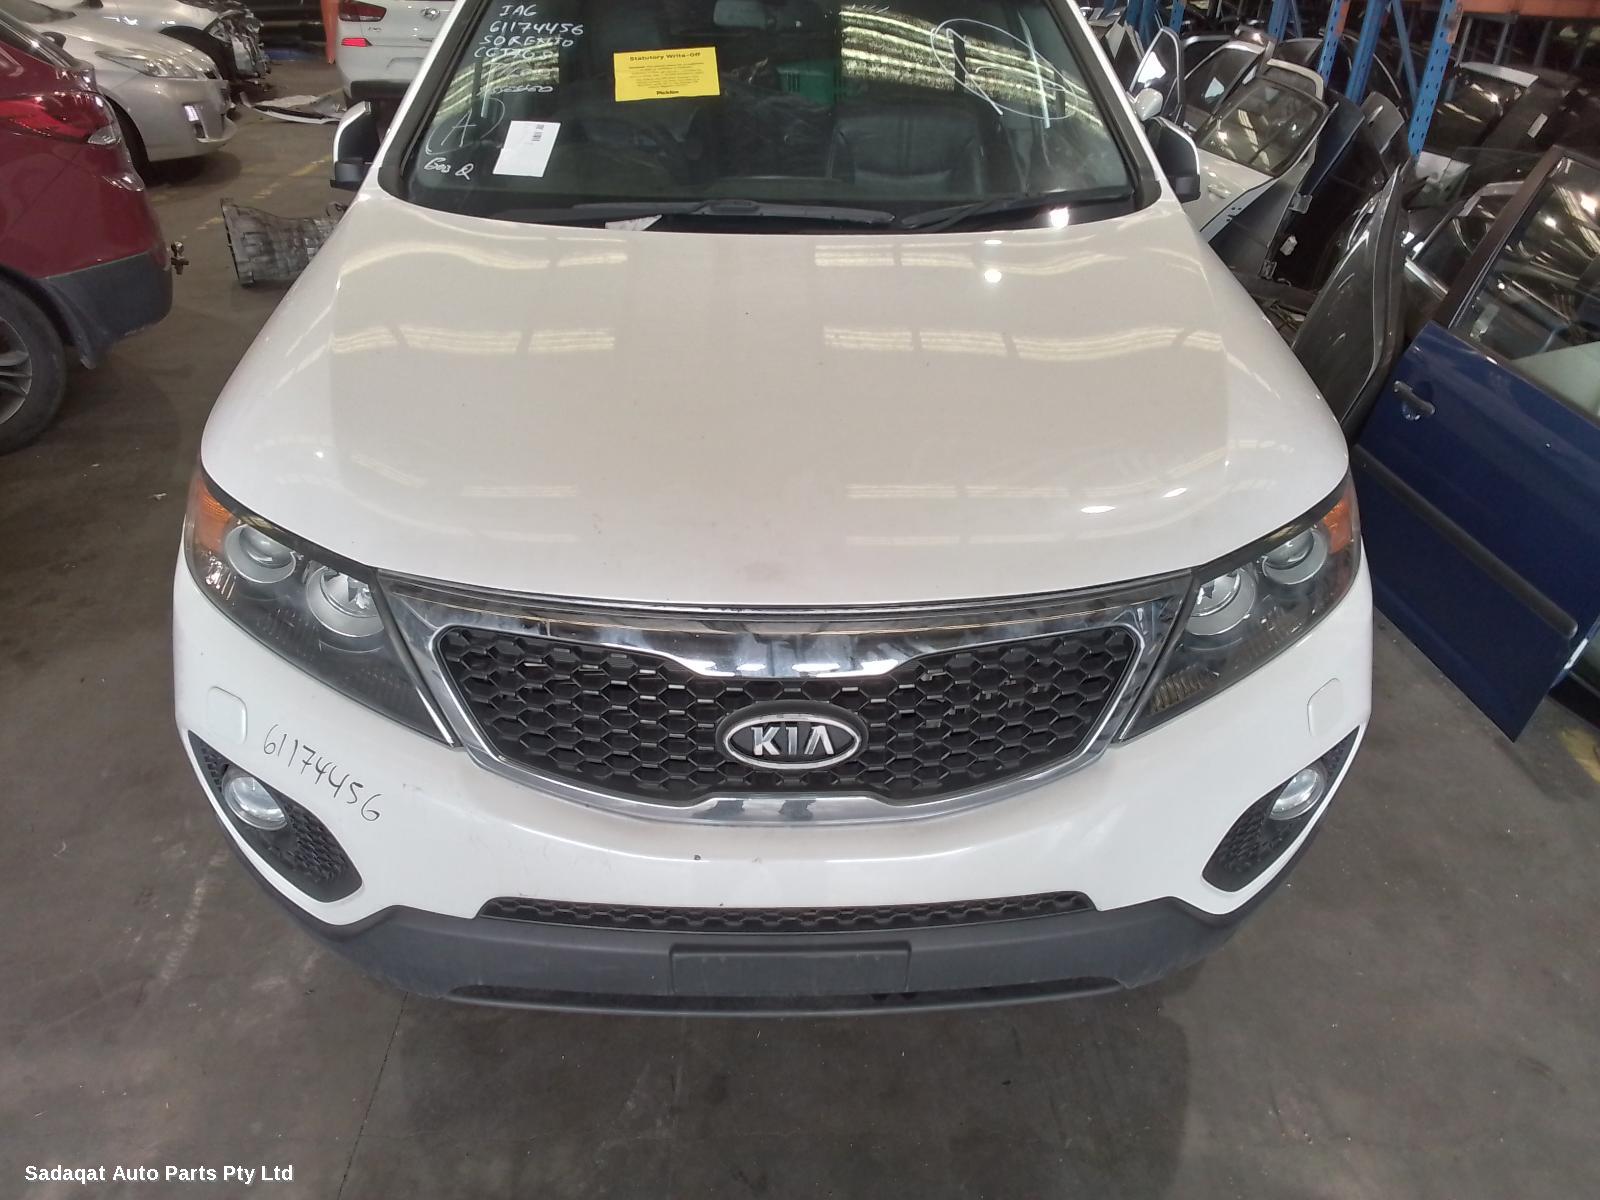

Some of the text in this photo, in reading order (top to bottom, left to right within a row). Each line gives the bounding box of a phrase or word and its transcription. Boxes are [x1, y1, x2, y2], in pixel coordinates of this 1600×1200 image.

[500, 4, 537, 17] IAG
[489, 20, 584, 36] 61174456
[629, 54, 665, 62] Statutory
[751, 724, 835, 756] KIA
[263, 723, 382, 822] 61174456
